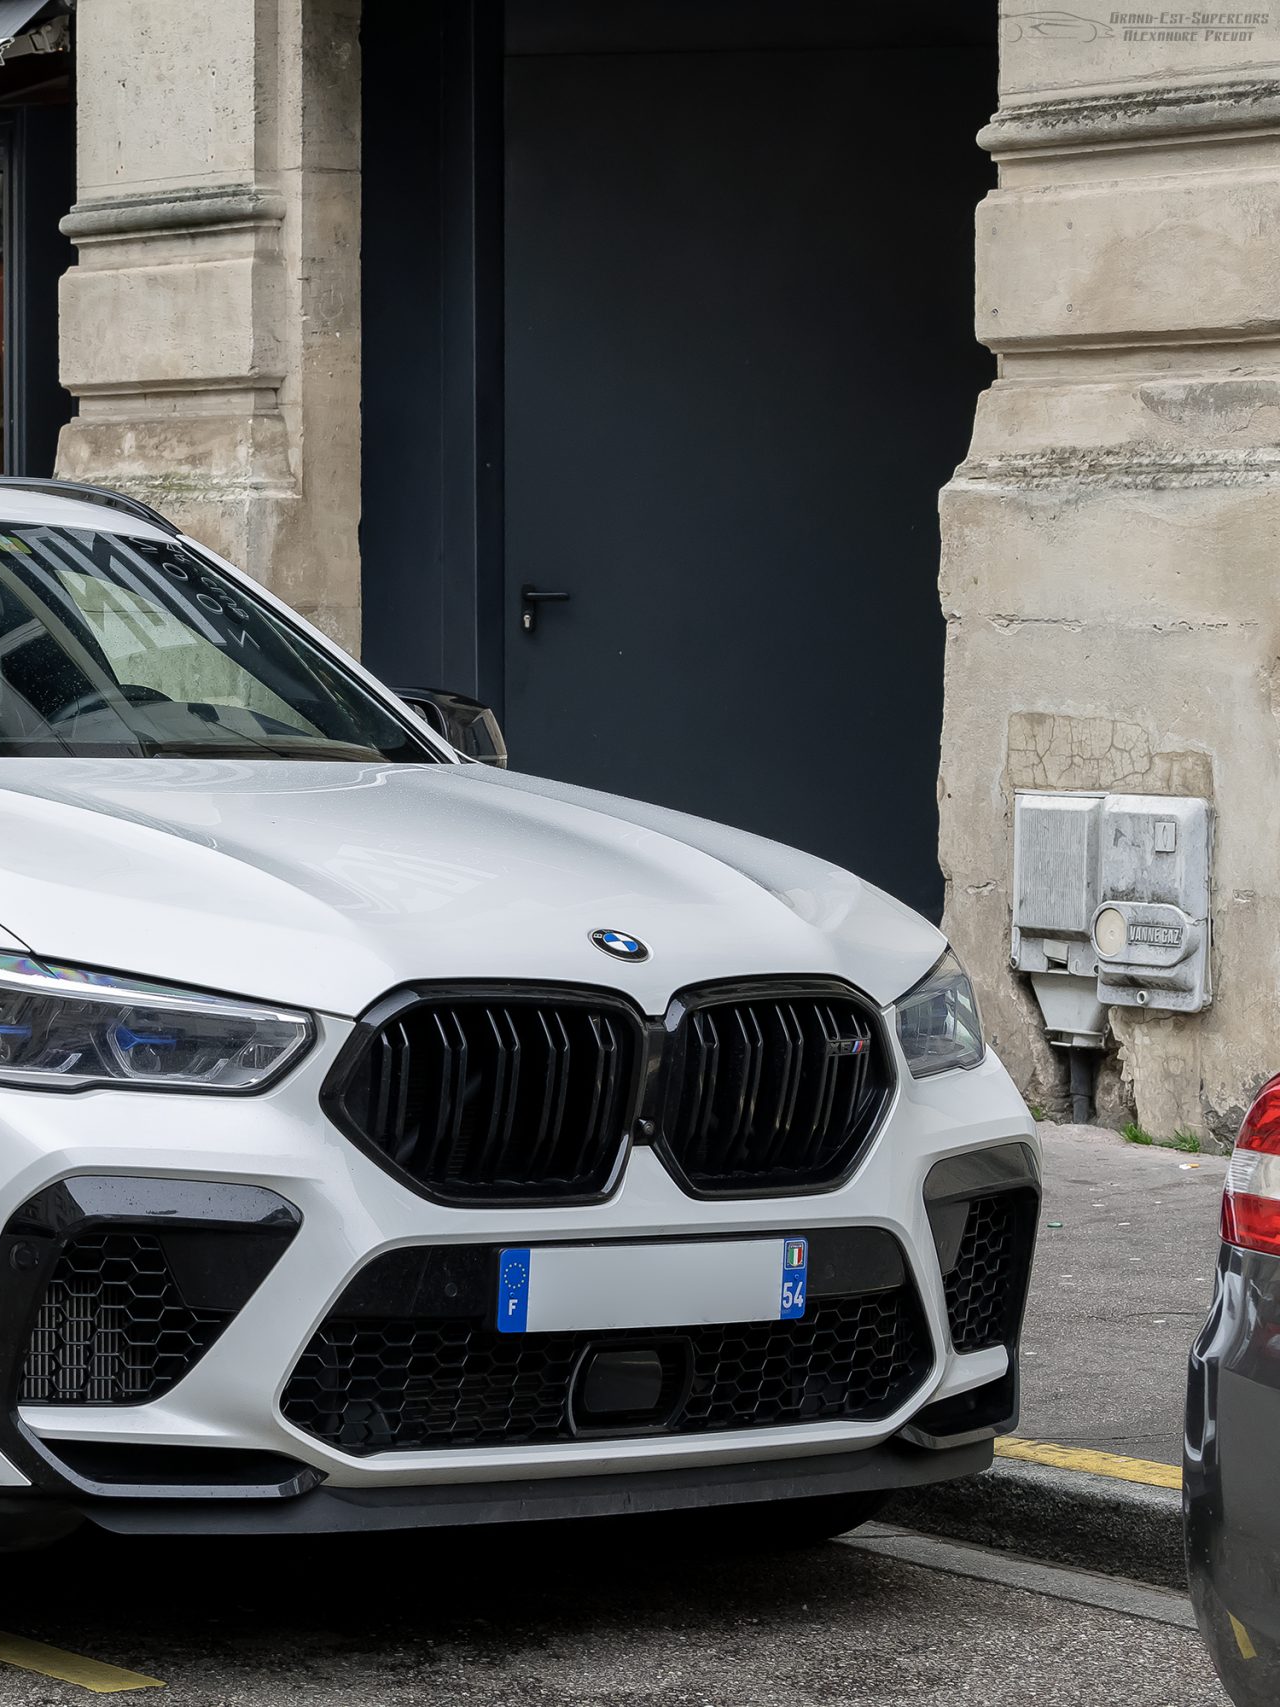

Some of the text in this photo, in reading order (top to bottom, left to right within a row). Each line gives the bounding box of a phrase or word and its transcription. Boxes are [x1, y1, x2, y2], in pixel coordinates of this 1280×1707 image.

[1128, 924, 1180, 945] VANNE GAZ
[782, 1280, 804, 1309] 54
[507, 1298, 519, 1316] F
